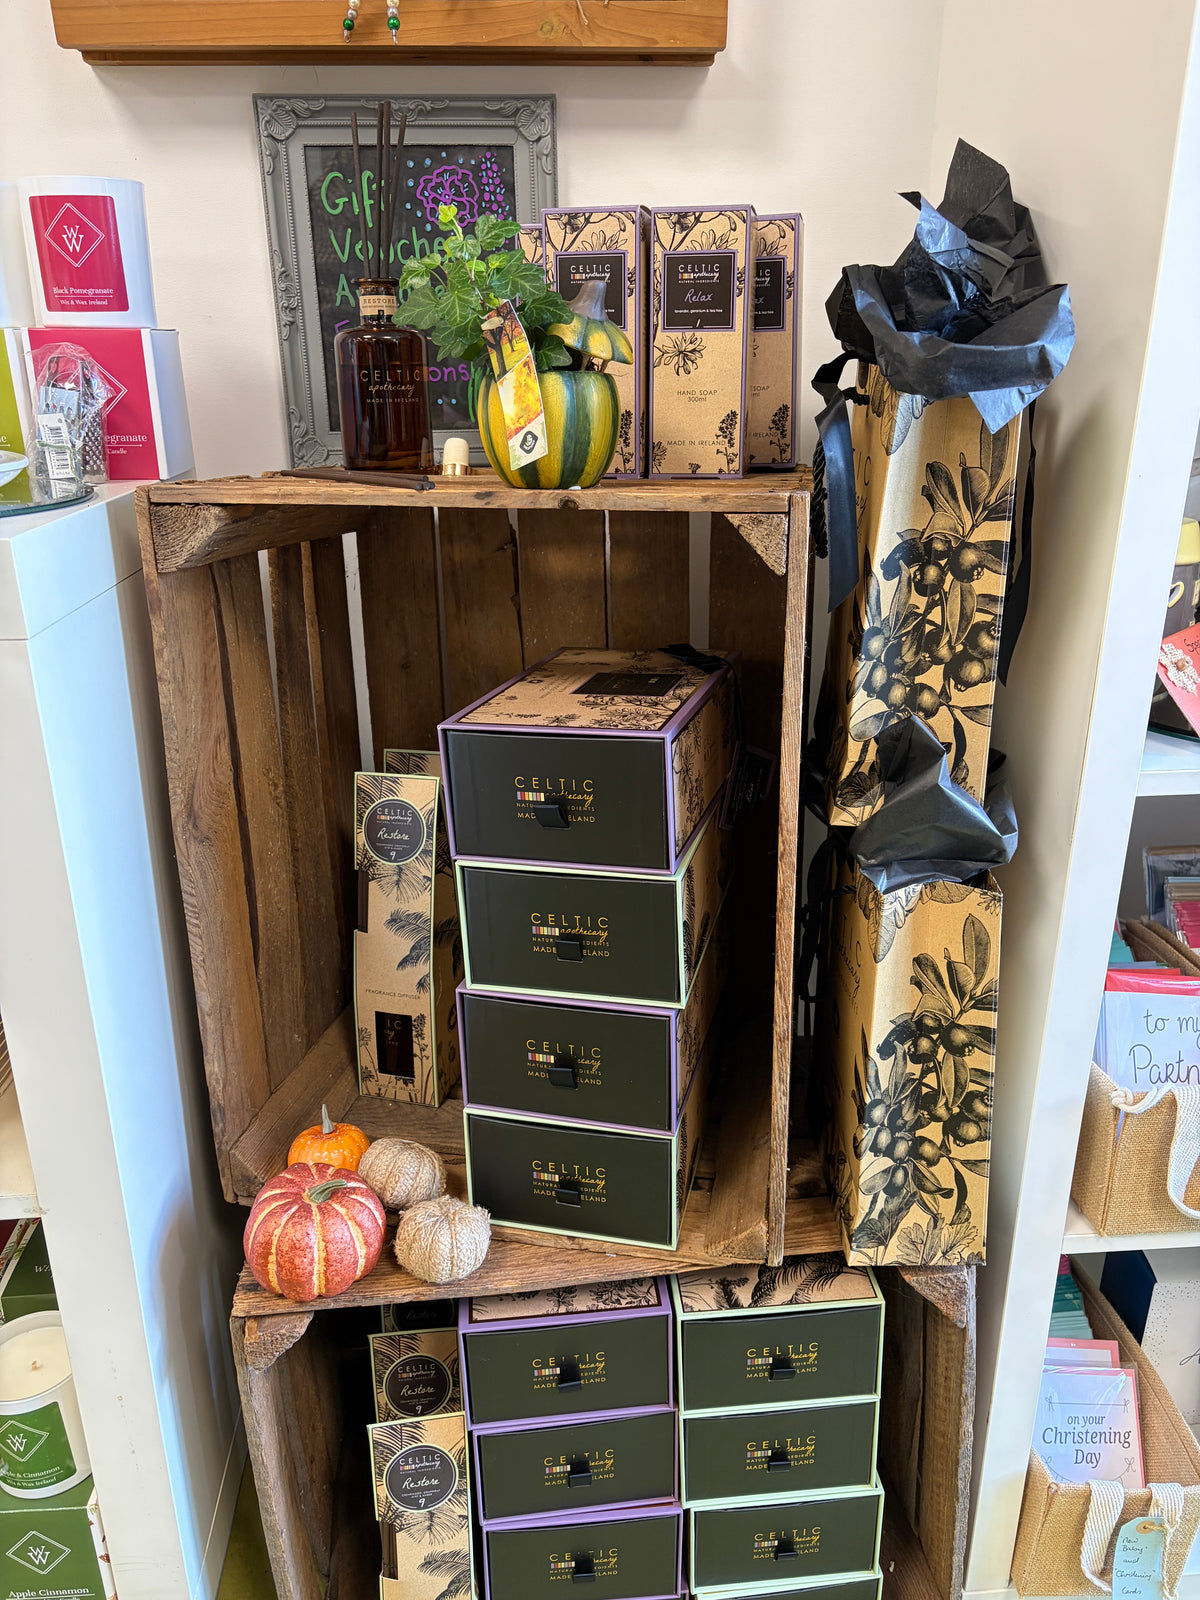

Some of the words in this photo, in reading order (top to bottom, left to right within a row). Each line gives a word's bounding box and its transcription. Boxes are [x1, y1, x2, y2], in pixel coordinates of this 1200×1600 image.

[321, 169, 384, 228] Gif
[570, 264, 611, 273] CELTIC
[678, 263, 720, 272] CELTIC
[53, 286, 69, 295] Black
[69, 287, 114, 296] Pomegranate
[684, 288, 714, 304] Relax
[360, 369, 420, 381] CELTIC
[368, 381, 416, 397] apothecary
[105, 433, 148, 444] egranate
[514, 776, 594, 792] CELTIC
[376, 807, 413, 816] CELTIC
[517, 812, 536, 820] MAD
[567, 815, 596, 823] ELAND
[377, 827, 410, 840] Restore
[530, 912, 608, 928] CELTIC
[533, 946, 557, 954] MADE
[582, 949, 610, 957] ELAND
[1144, 1009, 1170, 1034] to
[526, 1039, 601, 1058] CELTIC
[1128, 1044, 1200, 1085] Partn
[577, 1077, 602, 1086] LAND
[532, 1160, 606, 1178] CELTIC
[533, 1188, 556, 1197] MADE
[580, 1194, 607, 1203] ELAND
[745, 1342, 819, 1357] CELTIC
[397, 1363, 436, 1373] CELTIC
[796, 1366, 818, 1374] LAND
[580, 1377, 606, 1385] ELAND
[400, 1384, 436, 1397] Restore
[1067, 1415, 1080, 1425] on
[1082, 1414, 1106, 1428] your
[746, 1435, 816, 1451] CELTIC
[1042, 1427, 1132, 1448] Christening
[400, 1453, 440, 1465] CELTIC
[1074, 1449, 1102, 1469] Day
[22, 1465, 60, 1478] Cinnamon
[35, 1476, 57, 1486] Ireland
[402, 1475, 440, 1489] Restore
[753, 1526, 821, 1541] CELTIC
[549, 1548, 618, 1562] CEIC
[8, 1589, 37, 1599] Apple
[38, 1587, 89, 1597] Cinnamon
